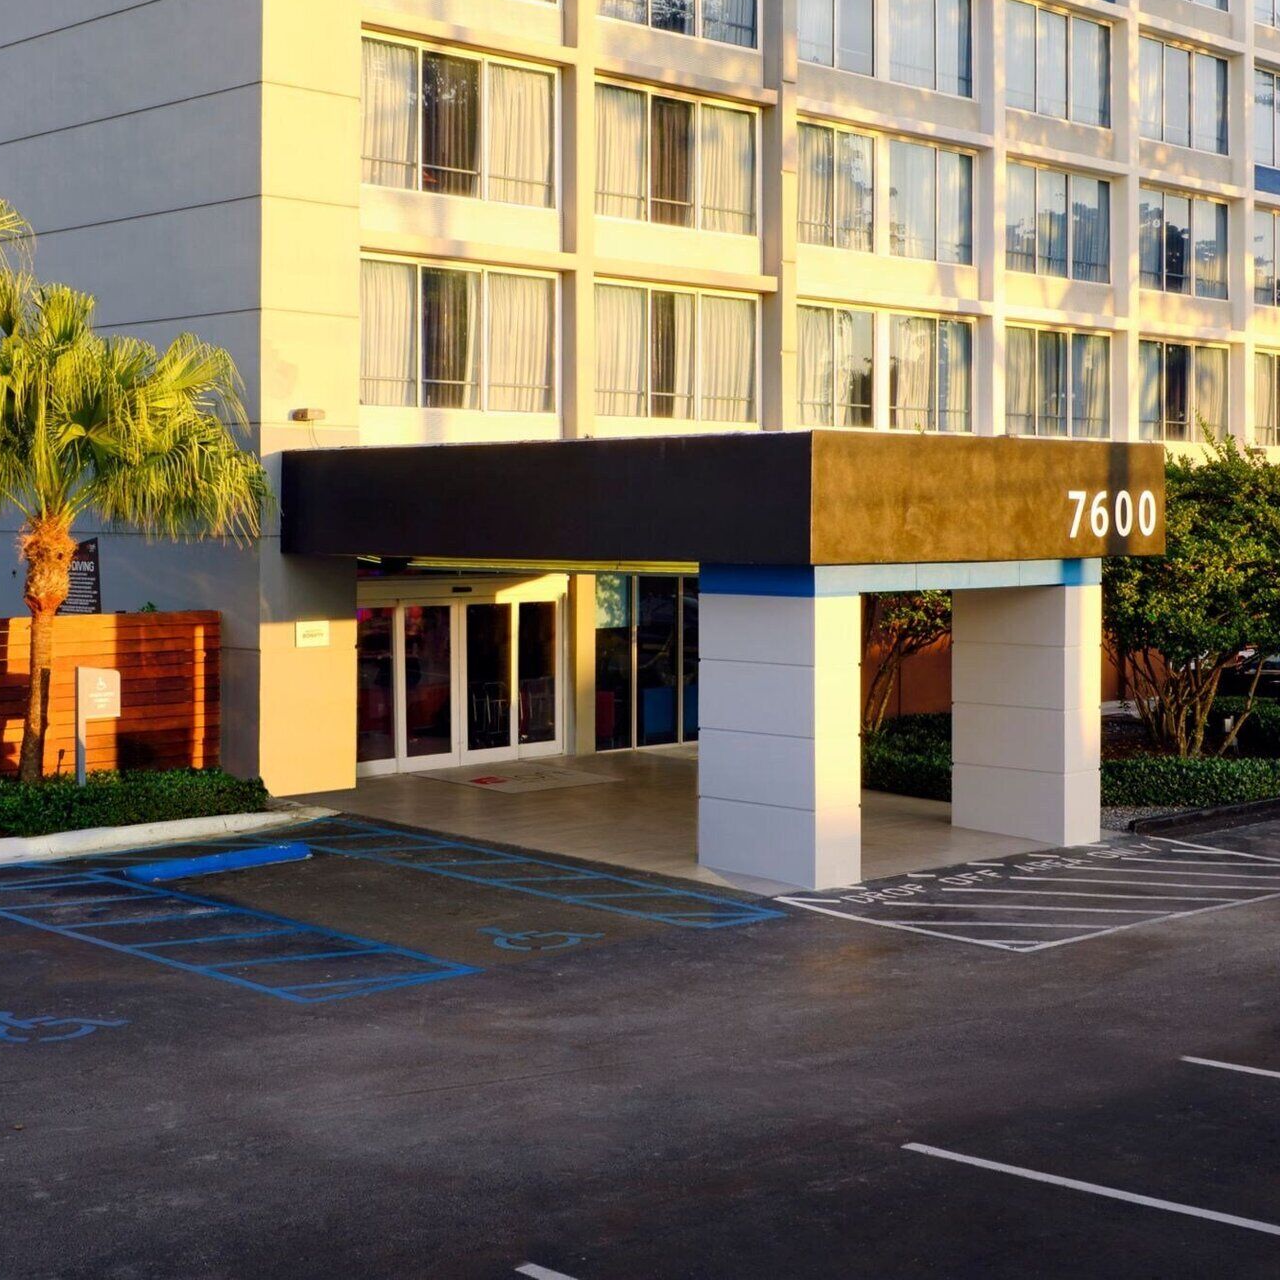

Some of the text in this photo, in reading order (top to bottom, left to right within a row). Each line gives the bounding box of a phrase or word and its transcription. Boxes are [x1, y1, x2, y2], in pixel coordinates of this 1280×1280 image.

[1068, 489, 1156, 538] 7600
[841, 842, 1162, 904] DROP OFF AREA ONLY
